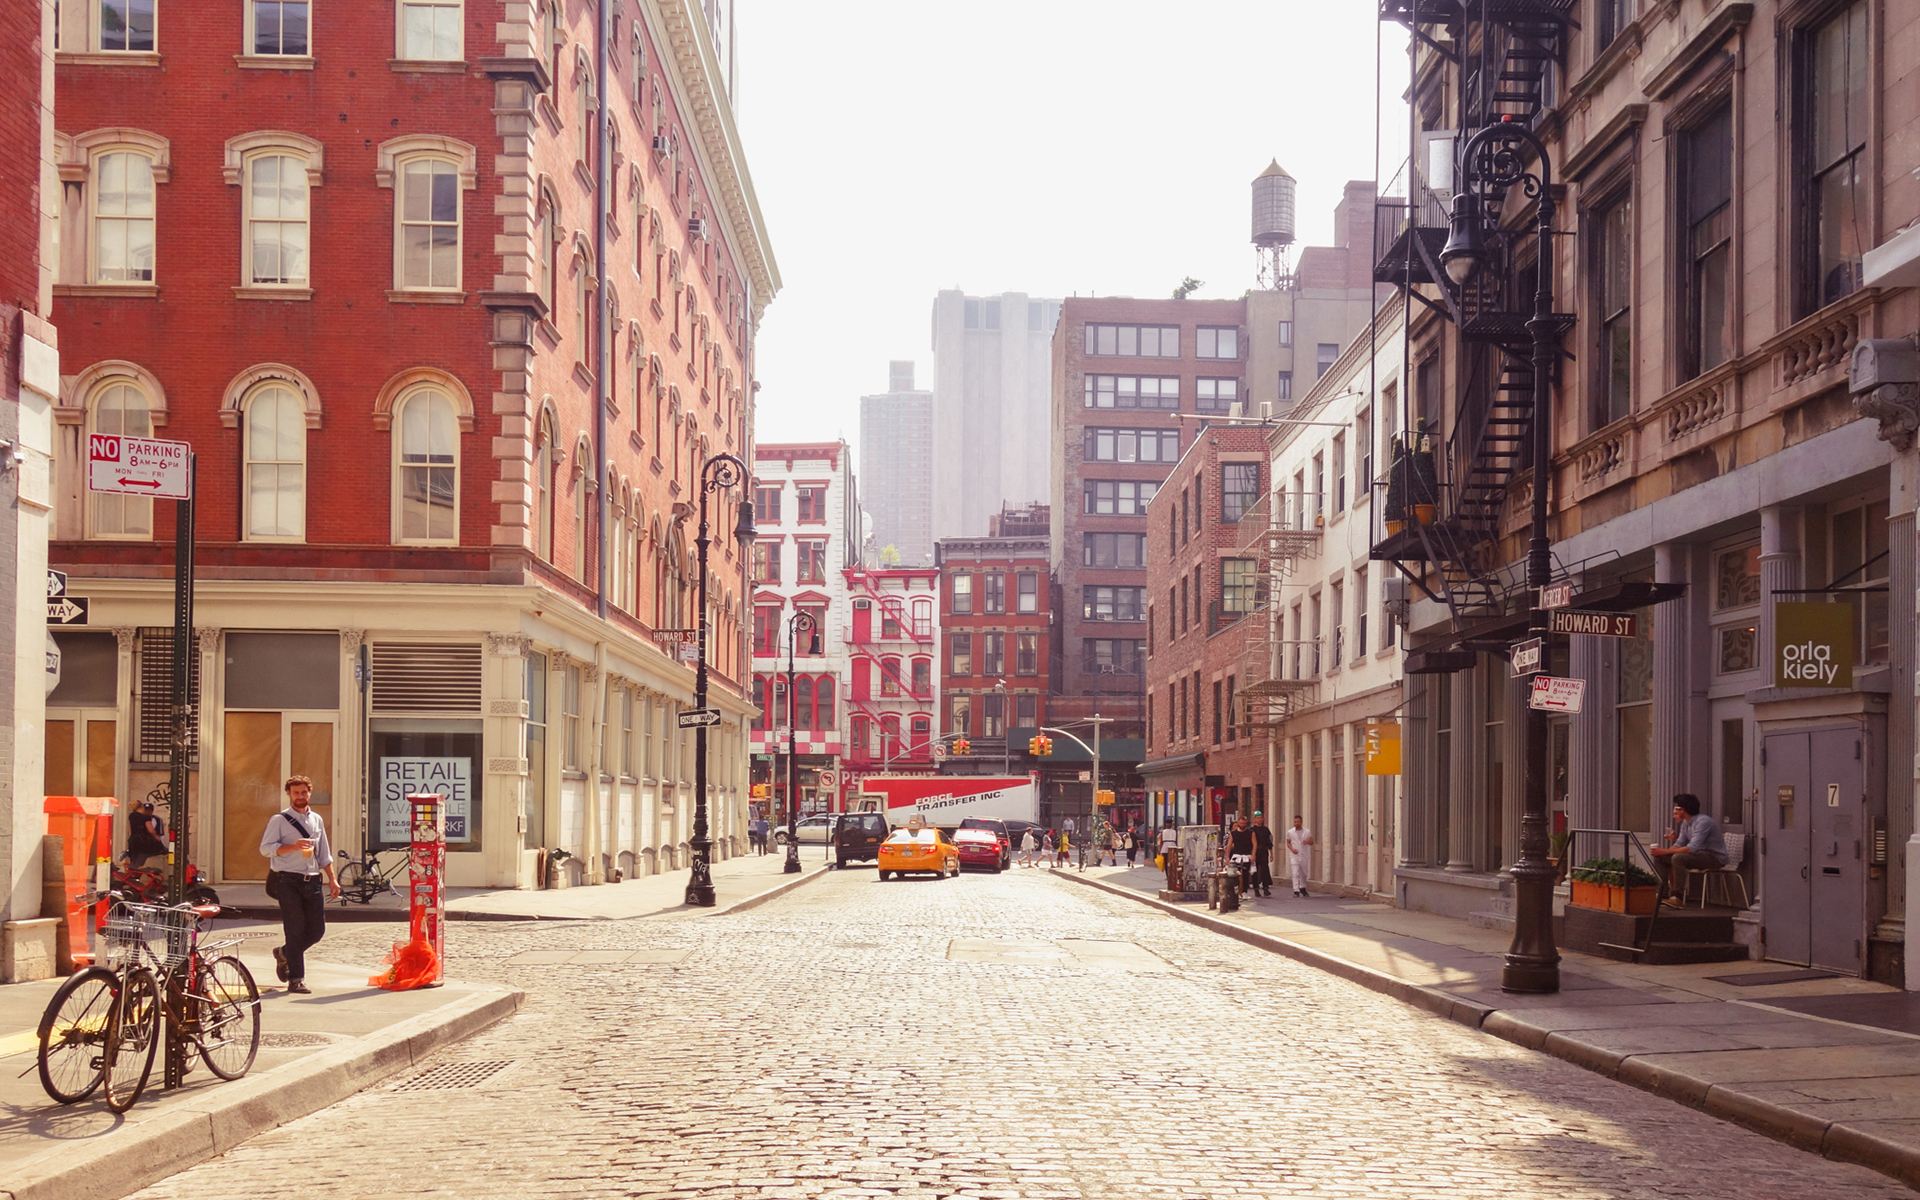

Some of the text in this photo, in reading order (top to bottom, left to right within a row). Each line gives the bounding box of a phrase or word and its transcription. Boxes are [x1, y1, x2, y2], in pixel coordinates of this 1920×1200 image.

[92, 438, 181, 459] NO PARKING
[115, 467, 132, 475] MON
[48, 580, 58, 592] AY
[48, 605, 74, 616] WAY
[1555, 613, 1631, 635] HOWARD ST
[653, 631, 696, 642] HOWARD ST
[1783, 640, 1831, 661] orla
[1783, 659, 1839, 685] kiely
[1535, 678, 1580, 690] NO PARKING
[681, 713, 715, 724] ONE WAY
[385, 762, 466, 780] RETAIL
[915, 795, 977, 812] TRANSFER
[1829, 785, 1838, 805] 7
